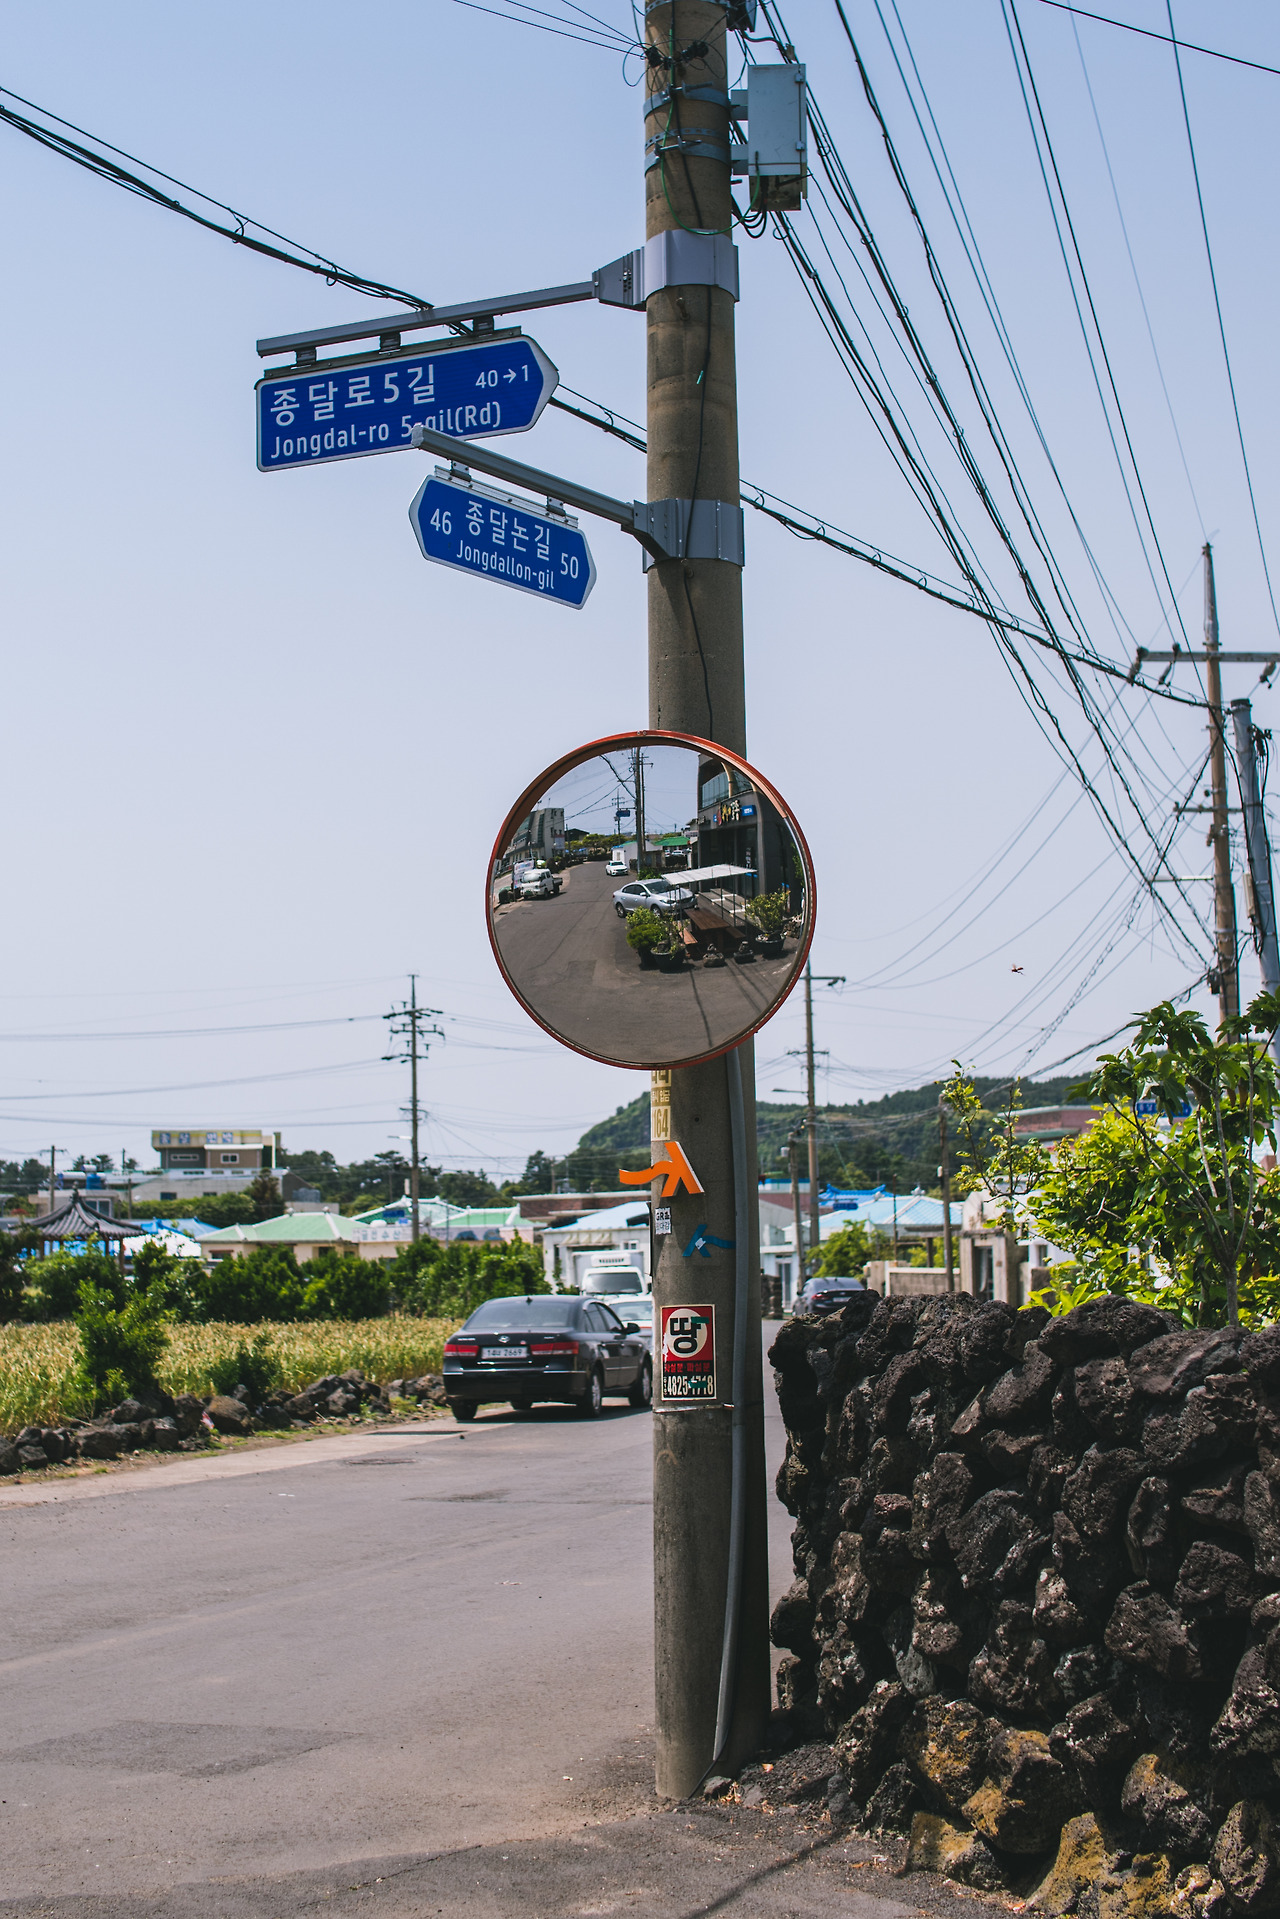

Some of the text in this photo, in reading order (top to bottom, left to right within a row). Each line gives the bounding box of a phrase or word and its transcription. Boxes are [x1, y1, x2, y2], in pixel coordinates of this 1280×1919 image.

[270, 364, 435, 427] 종달로5길
[475, 364, 529, 389] 40 1
[271, 423, 390, 459] Jongdal-ro
[430, 500, 579, 579] 46 종달논길 50
[456, 539, 555, 590] Jongdallon-gil
[670, 1317, 702, 1354] 땅
